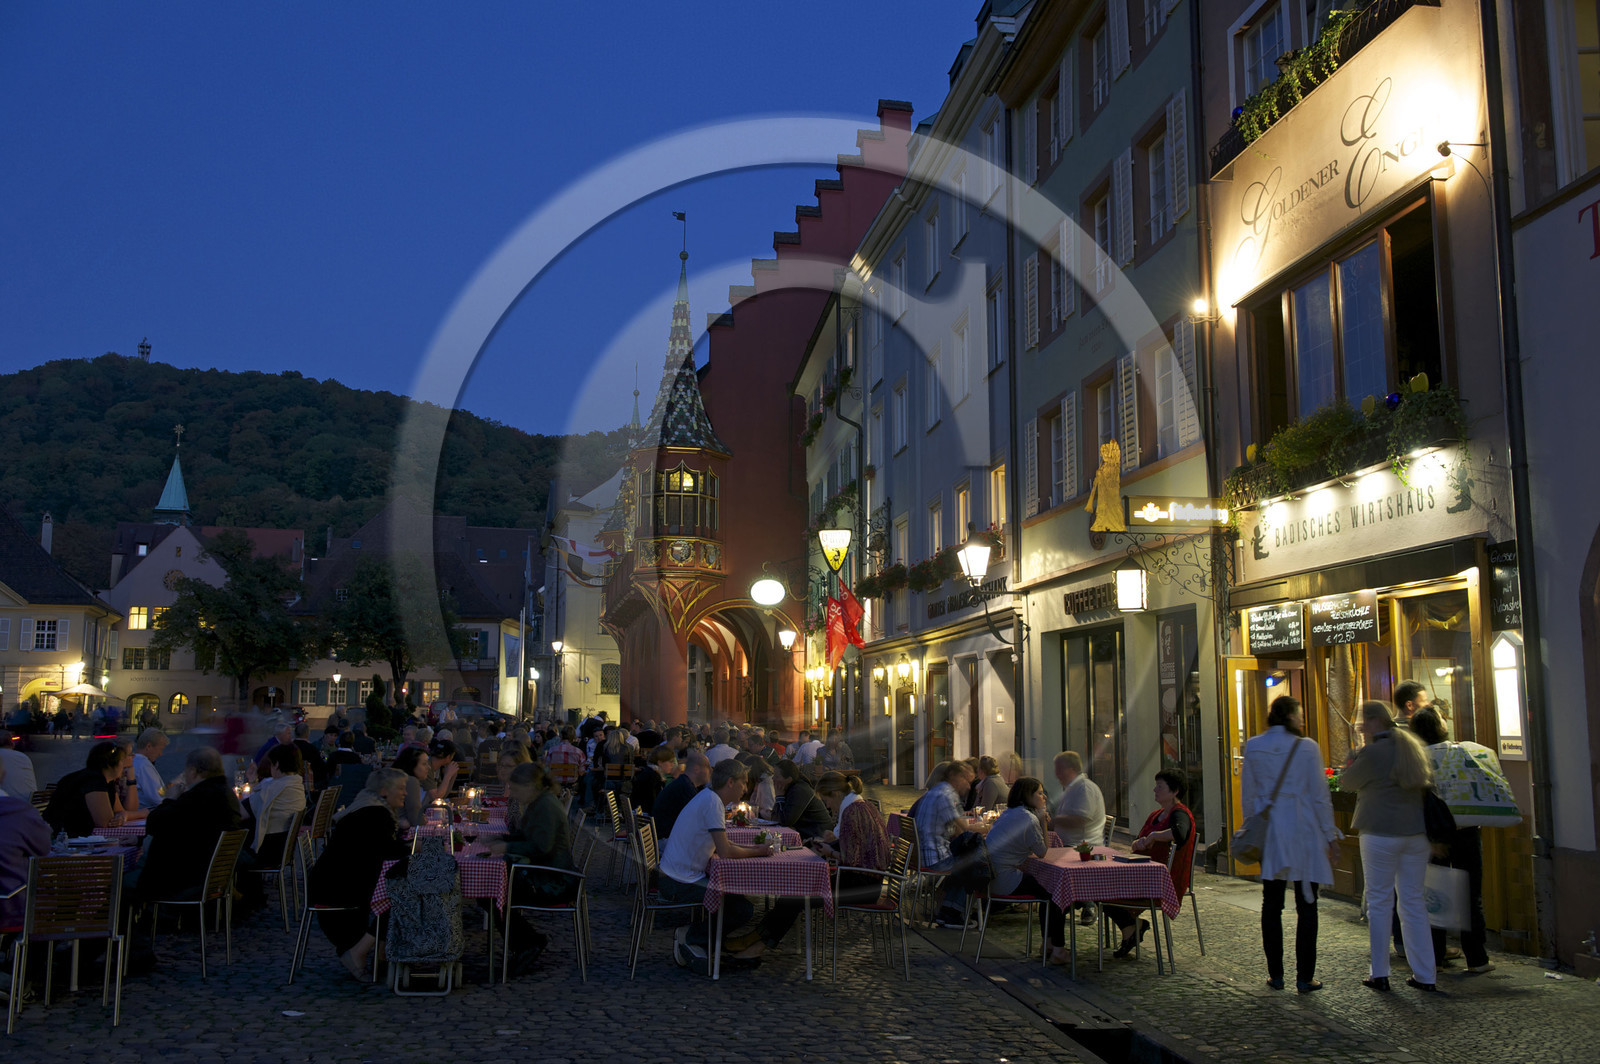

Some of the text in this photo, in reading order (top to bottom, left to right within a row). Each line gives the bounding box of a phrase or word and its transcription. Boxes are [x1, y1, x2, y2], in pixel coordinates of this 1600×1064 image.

[1275, 484, 1436, 548] BADISCHES WIRTSHAUS
[1064, 587, 1094, 615] COFFEE
